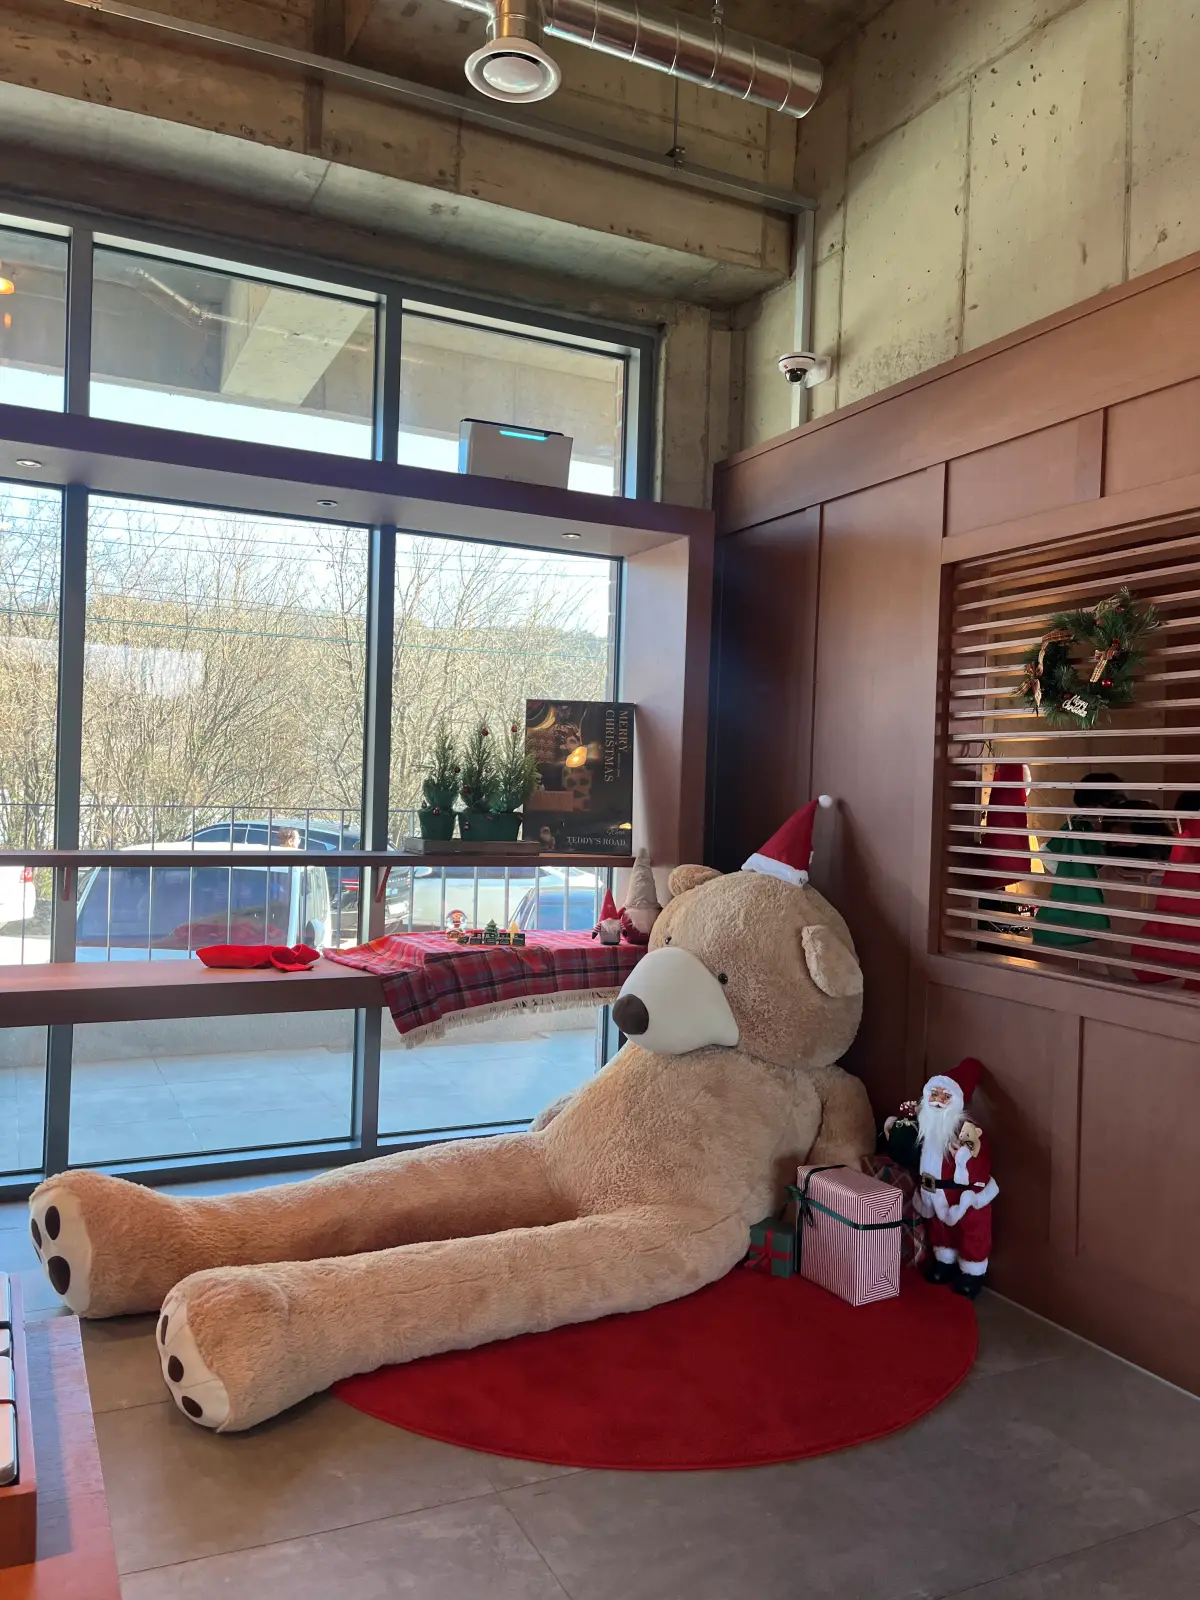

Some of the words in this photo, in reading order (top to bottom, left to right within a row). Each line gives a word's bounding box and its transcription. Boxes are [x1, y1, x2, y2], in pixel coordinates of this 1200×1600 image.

[605, 709, 615, 782] CHRISTMAS
[618, 710, 628, 753] MERRY
[566, 836, 601, 845] TEDDY'S
[602, 838, 626, 846] ROAD
